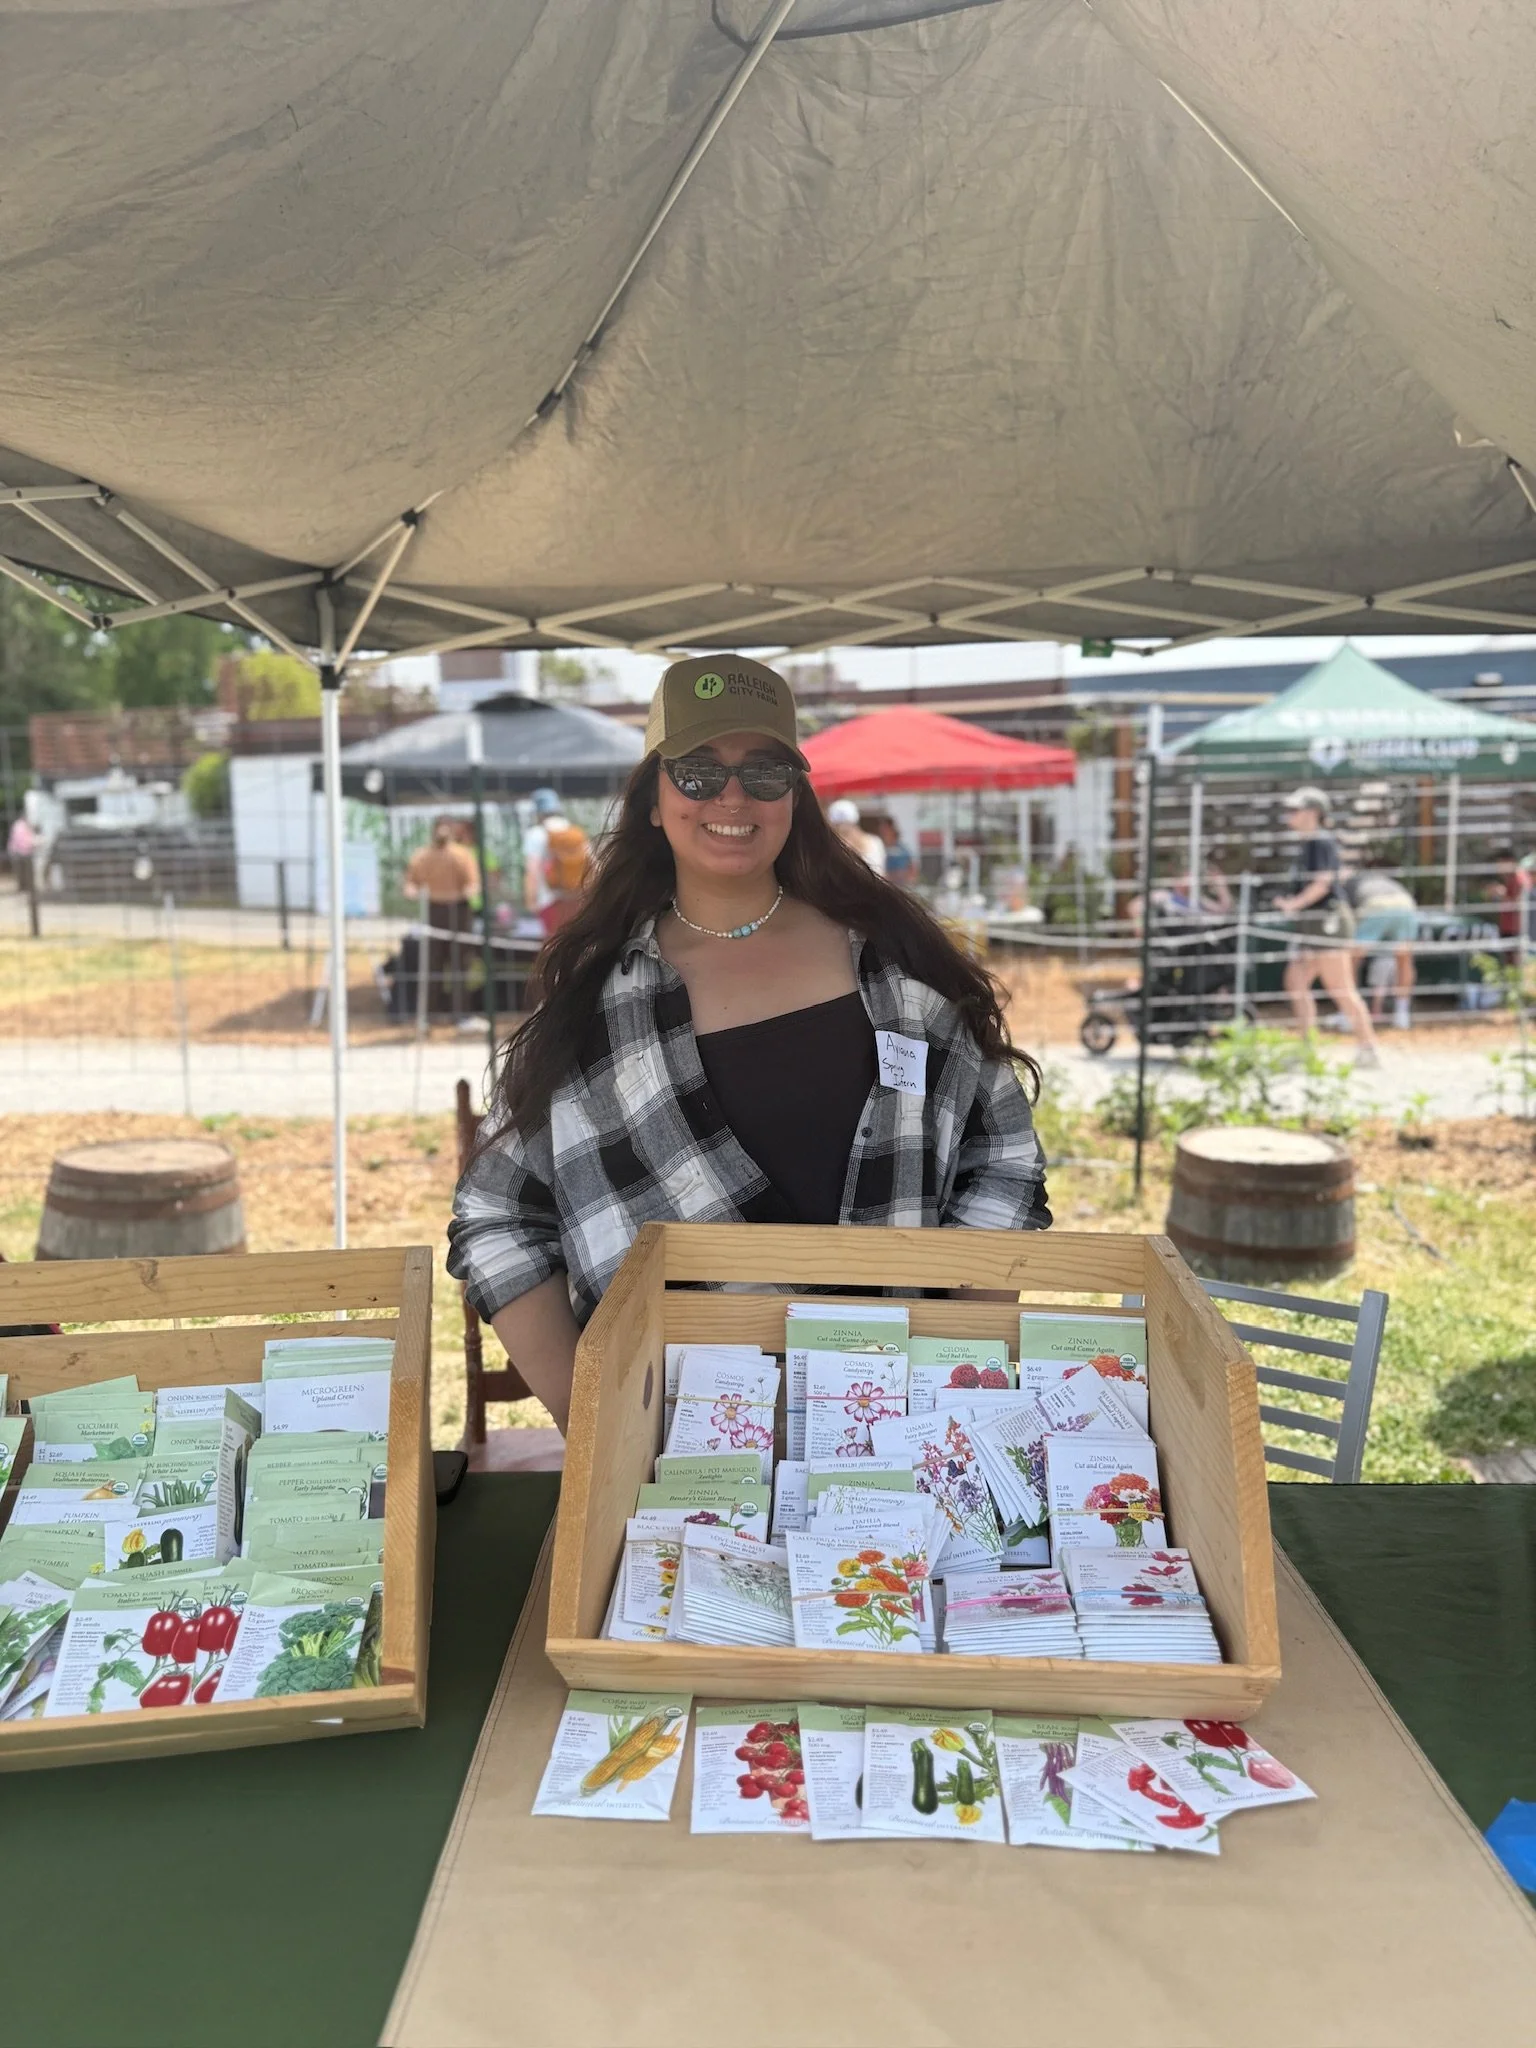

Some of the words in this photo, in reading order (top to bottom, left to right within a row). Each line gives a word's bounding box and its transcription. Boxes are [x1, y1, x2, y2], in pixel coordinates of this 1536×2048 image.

[728, 673, 776, 698] RALEIGH
[729, 686, 753, 697] CITY
[833, 1329, 862, 1338] ZINNIA
[1067, 1337, 1098, 1346] ZINNIA
[942, 1346, 970, 1354] CELOSIA
[1051, 1344, 1063, 1352] Cut
[1096, 1346, 1115, 1354] Again
[844, 1360, 874, 1369] COSMOS
[716, 1371, 745, 1382] COSMOS
[301, 1384, 365, 1397] MICROGREENS
[312, 1394, 336, 1404] Upland
[337, 1393, 355, 1401] Cress
[77, 1423, 119, 1431] CUCUMBER
[906, 1422, 934, 1434] LINARIA
[278, 1478, 306, 1487] PEPPER
[688, 1488, 719, 1496] ZINNIA
[63, 1512, 100, 1520] PUMPKIN
[270, 1516, 303, 1525] TOMATO
[293, 1561, 328, 1570] TOMATO
[131, 1570, 165, 1582] SQUASH
[102, 1591, 140, 1599] TOMATO
[602, 1697, 627, 1705] CORN
